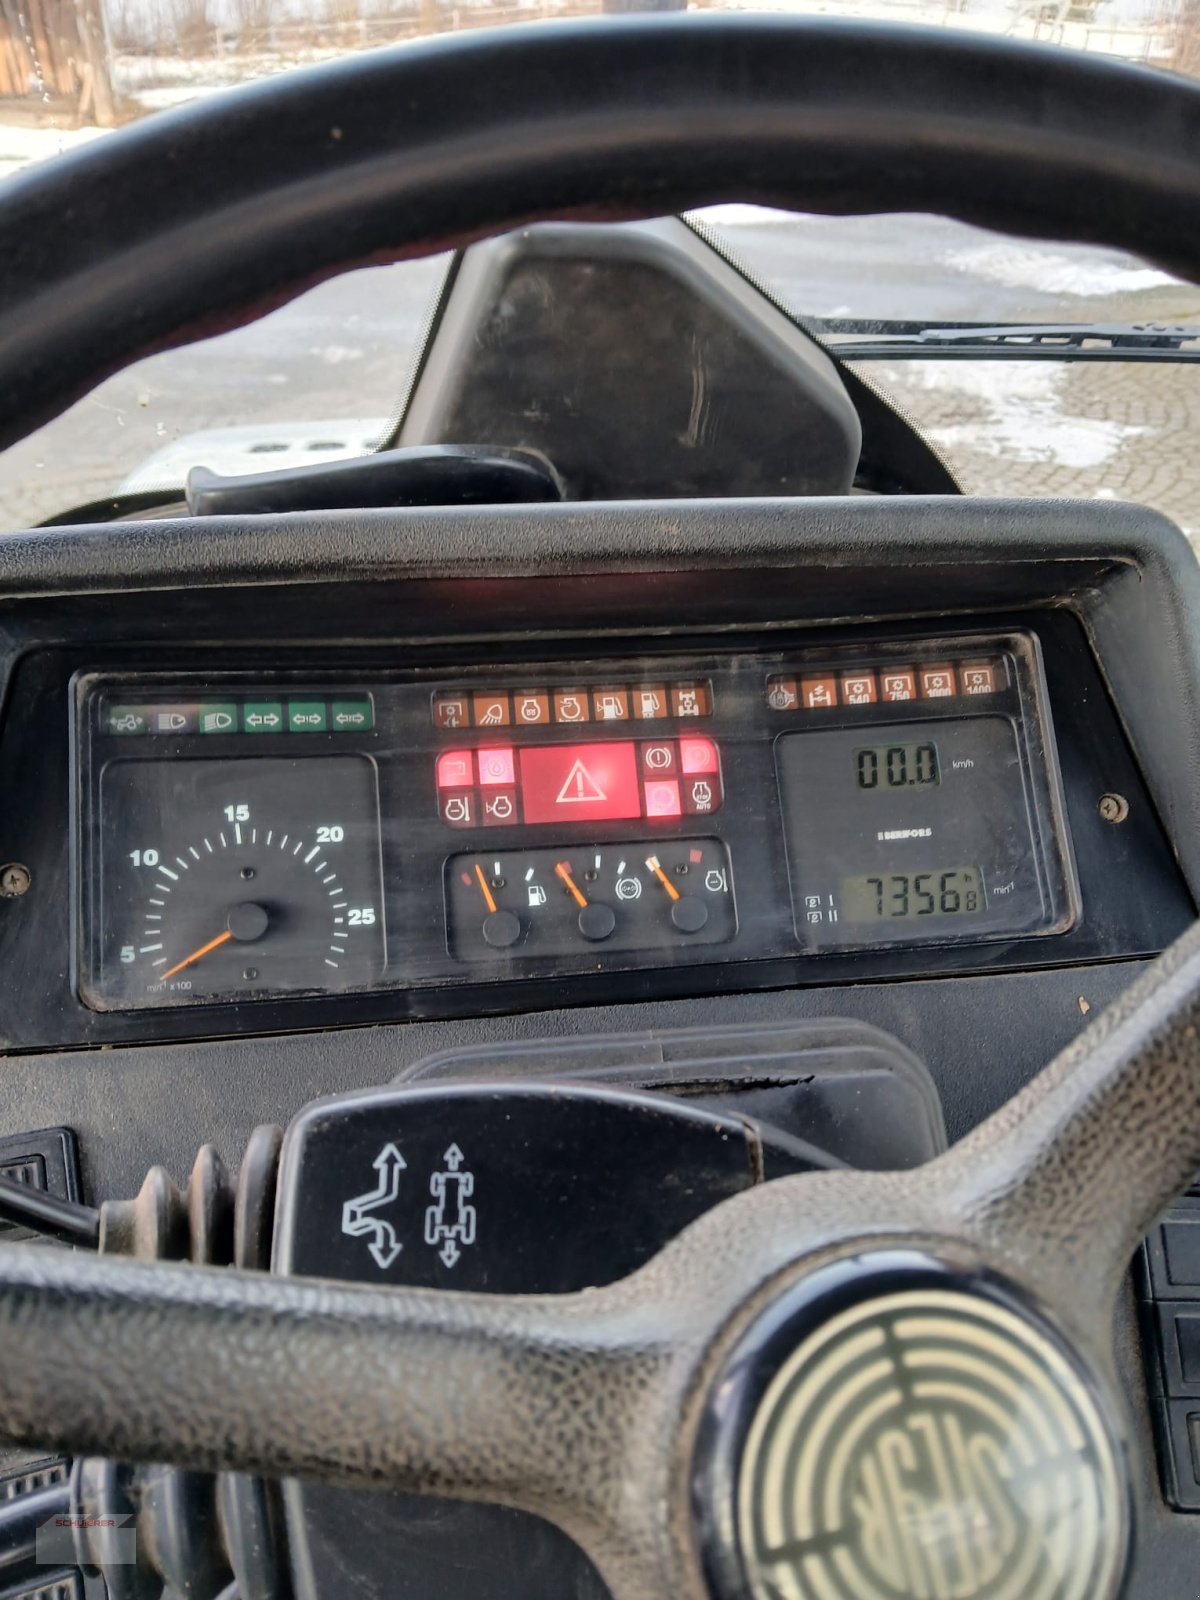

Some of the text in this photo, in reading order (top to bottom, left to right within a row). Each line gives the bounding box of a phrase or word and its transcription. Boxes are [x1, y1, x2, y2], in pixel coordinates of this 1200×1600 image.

[951, 758, 975, 770] km/h
[223, 804, 250, 823] 15
[696, 802, 712, 811] AUTO
[316, 825, 344, 843] 20
[129, 849, 159, 867] 10
[347, 908, 376, 926] 25
[119, 946, 136, 964] 5
